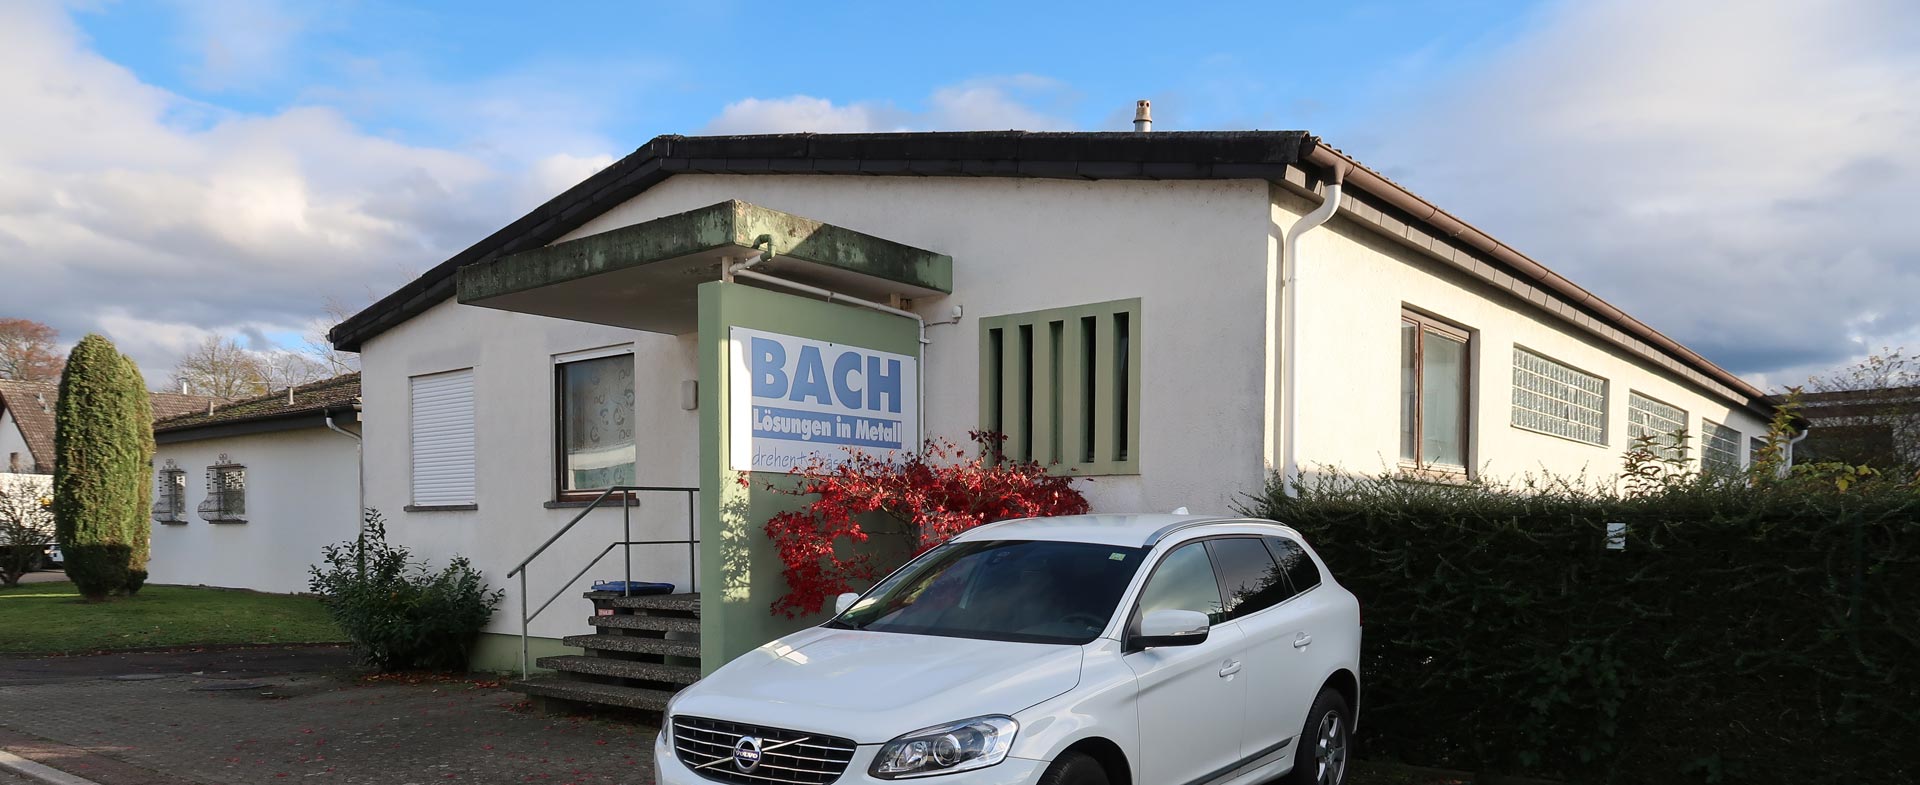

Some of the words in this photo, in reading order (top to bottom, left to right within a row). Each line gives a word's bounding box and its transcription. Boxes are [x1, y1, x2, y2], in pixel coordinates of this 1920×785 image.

[751, 336, 902, 414] BACH
[753, 408, 832, 440] Lösungen
[836, 415, 851, 437] in
[855, 419, 902, 443] Metall
[735, 750, 758, 759] VOLVO
